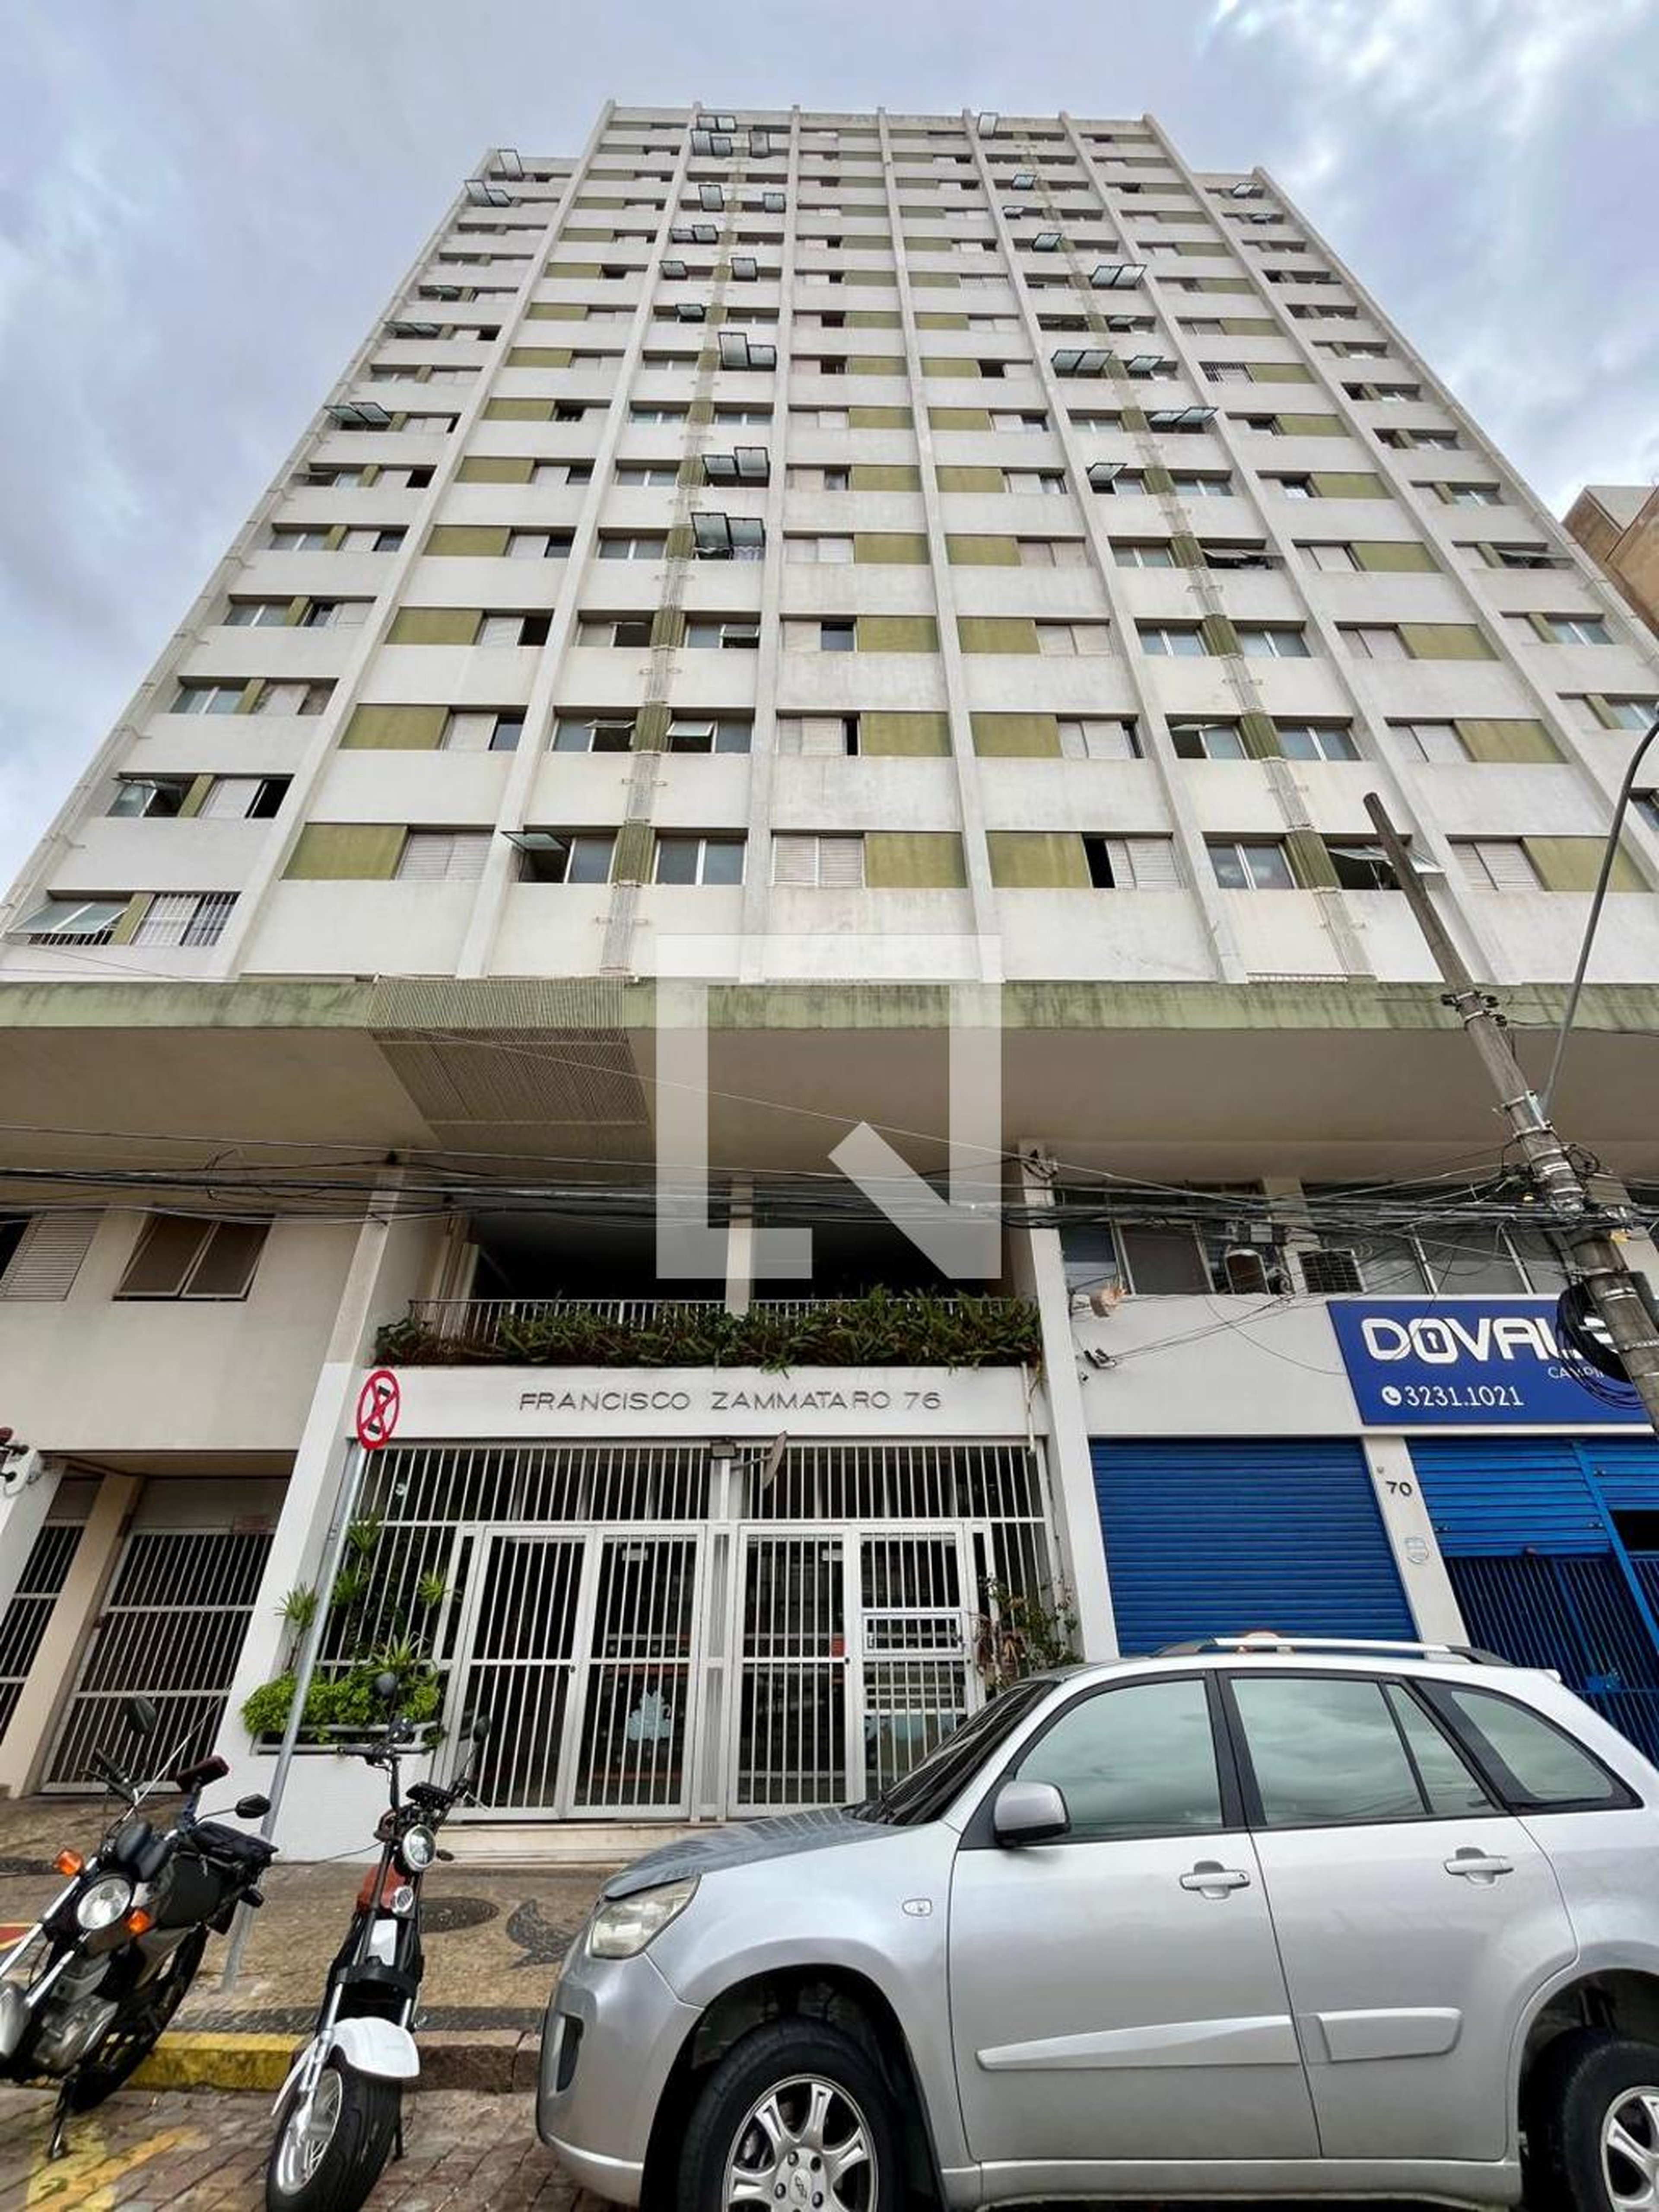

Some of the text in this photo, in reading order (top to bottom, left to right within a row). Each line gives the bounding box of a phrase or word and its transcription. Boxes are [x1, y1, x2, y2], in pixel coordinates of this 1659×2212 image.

[519, 1391, 942, 1411] FRANCISCO ZAMMATARO 76
[1405, 1385, 1525, 1407] 3231.1021
[1386, 1481, 1413, 1497] 70
